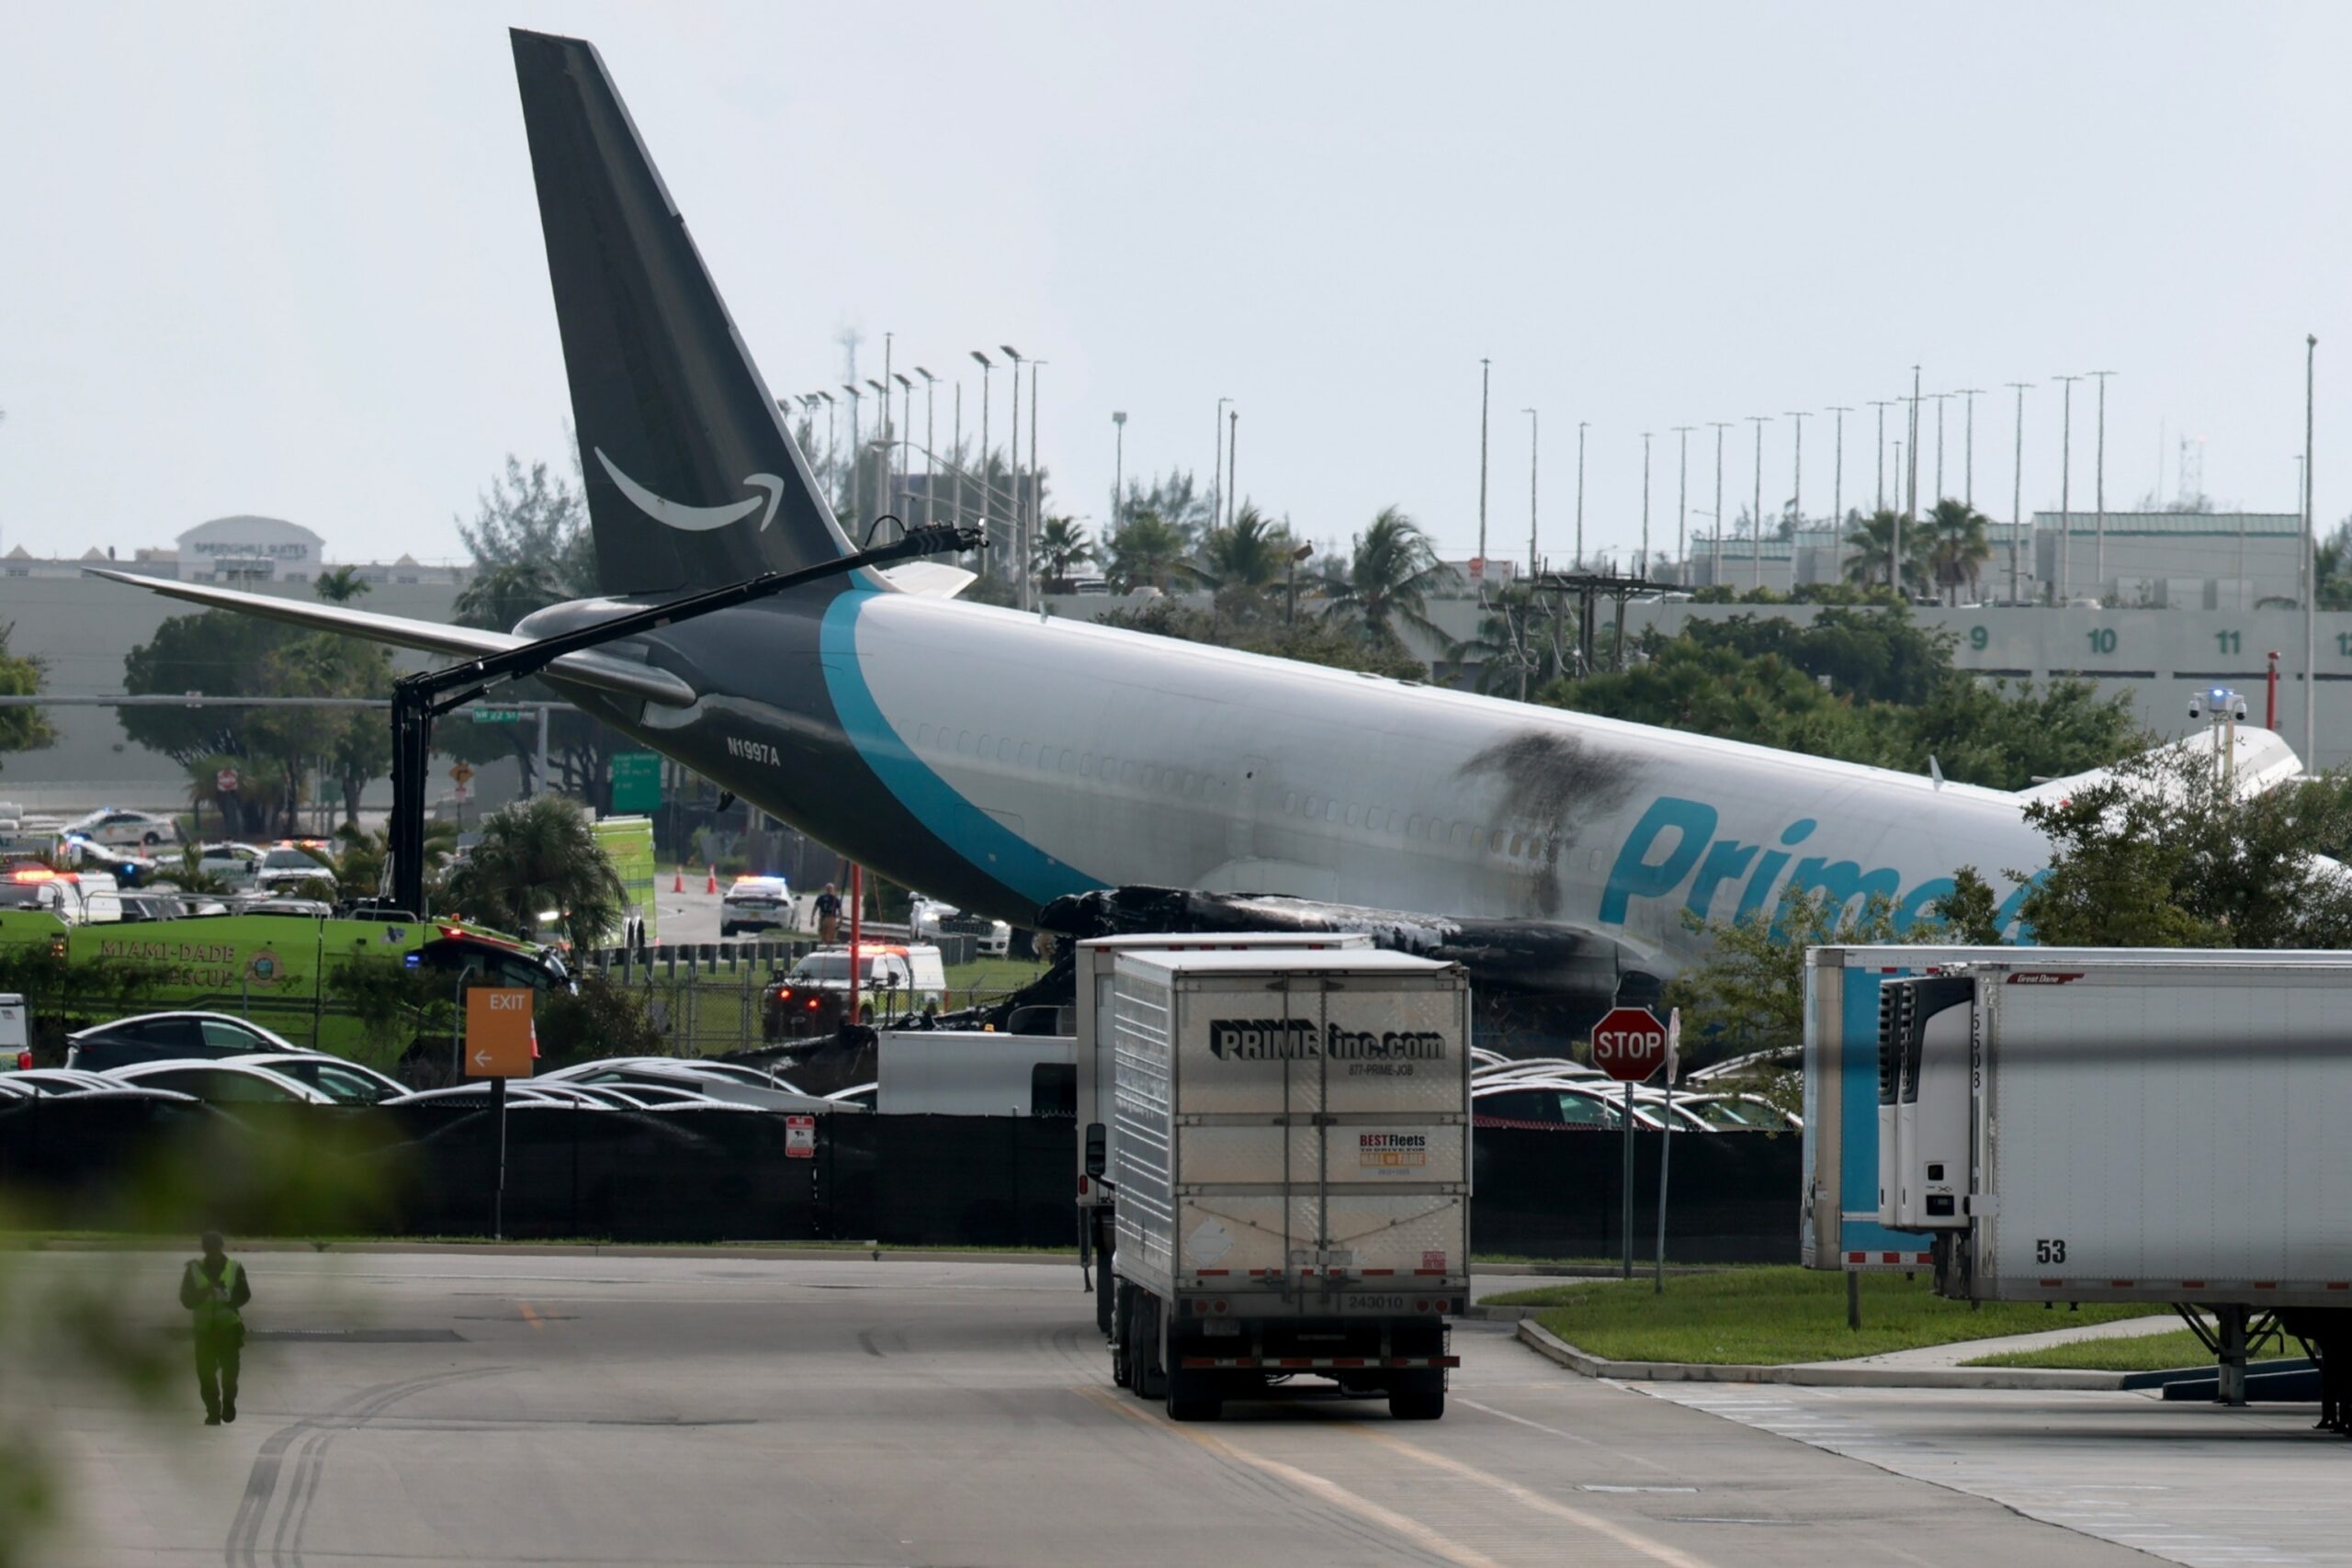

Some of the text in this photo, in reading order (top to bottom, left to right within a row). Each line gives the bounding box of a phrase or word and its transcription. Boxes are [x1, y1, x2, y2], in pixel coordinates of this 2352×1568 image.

[1970, 626, 1989, 651] 9
[2087, 627, 2116, 654] 10
[2215, 629, 2242, 655] 11
[727, 736, 781, 767] N1997A
[1599, 795, 1959, 945] Prime
[101, 940, 235, 964] MIAMI-DADE
[161, 967, 235, 988] ESCUE
[2017, 974, 2059, 983] Great Dane
[490, 994, 526, 1010] EXIT
[1210, 1020, 1446, 1060] PRIME inc.com
[1598, 1032, 1662, 1059] STOP
[1349, 1064, 1414, 1077] 877-PRIME-JOB
[1360, 1134, 1426, 1146] BEST Fleets
[2037, 1239, 2066, 1264] 53
[1349, 1296, 1403, 1309] 243010
